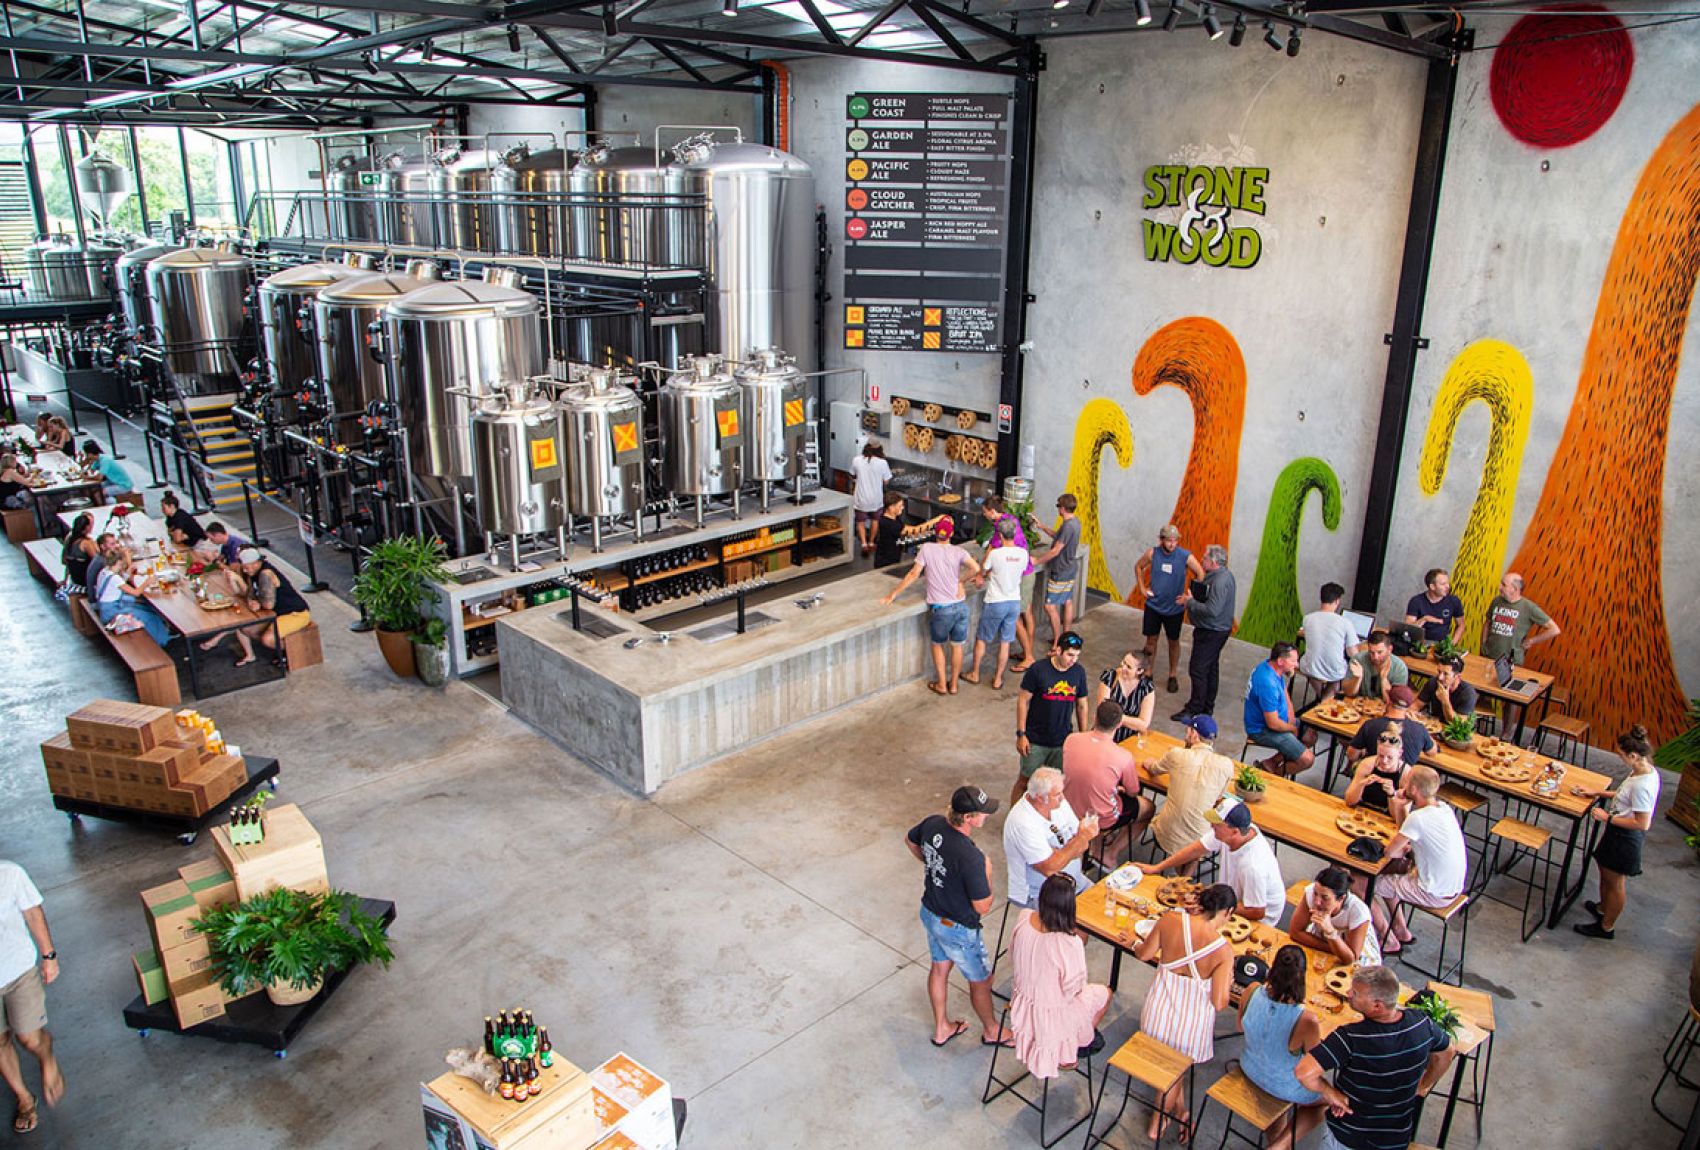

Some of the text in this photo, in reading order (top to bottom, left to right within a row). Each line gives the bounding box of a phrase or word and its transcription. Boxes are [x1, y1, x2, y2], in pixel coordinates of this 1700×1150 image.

[873, 98, 906, 107] GREEN
[872, 109, 905, 117] COAST
[872, 131, 913, 140] GARDEN
[872, 141, 890, 150] ALE
[871, 161, 910, 171] PACIFIC
[871, 171, 890, 180] ALE
[1142, 165, 1269, 216] STONE
[870, 191, 906, 200] CLOUD
[870, 201, 915, 210] CATCHER
[1179, 188, 1231, 250] &
[870, 220, 906, 230] JASPER
[870, 230, 889, 239] ALE
[1142, 218, 1262, 269] WOOD
